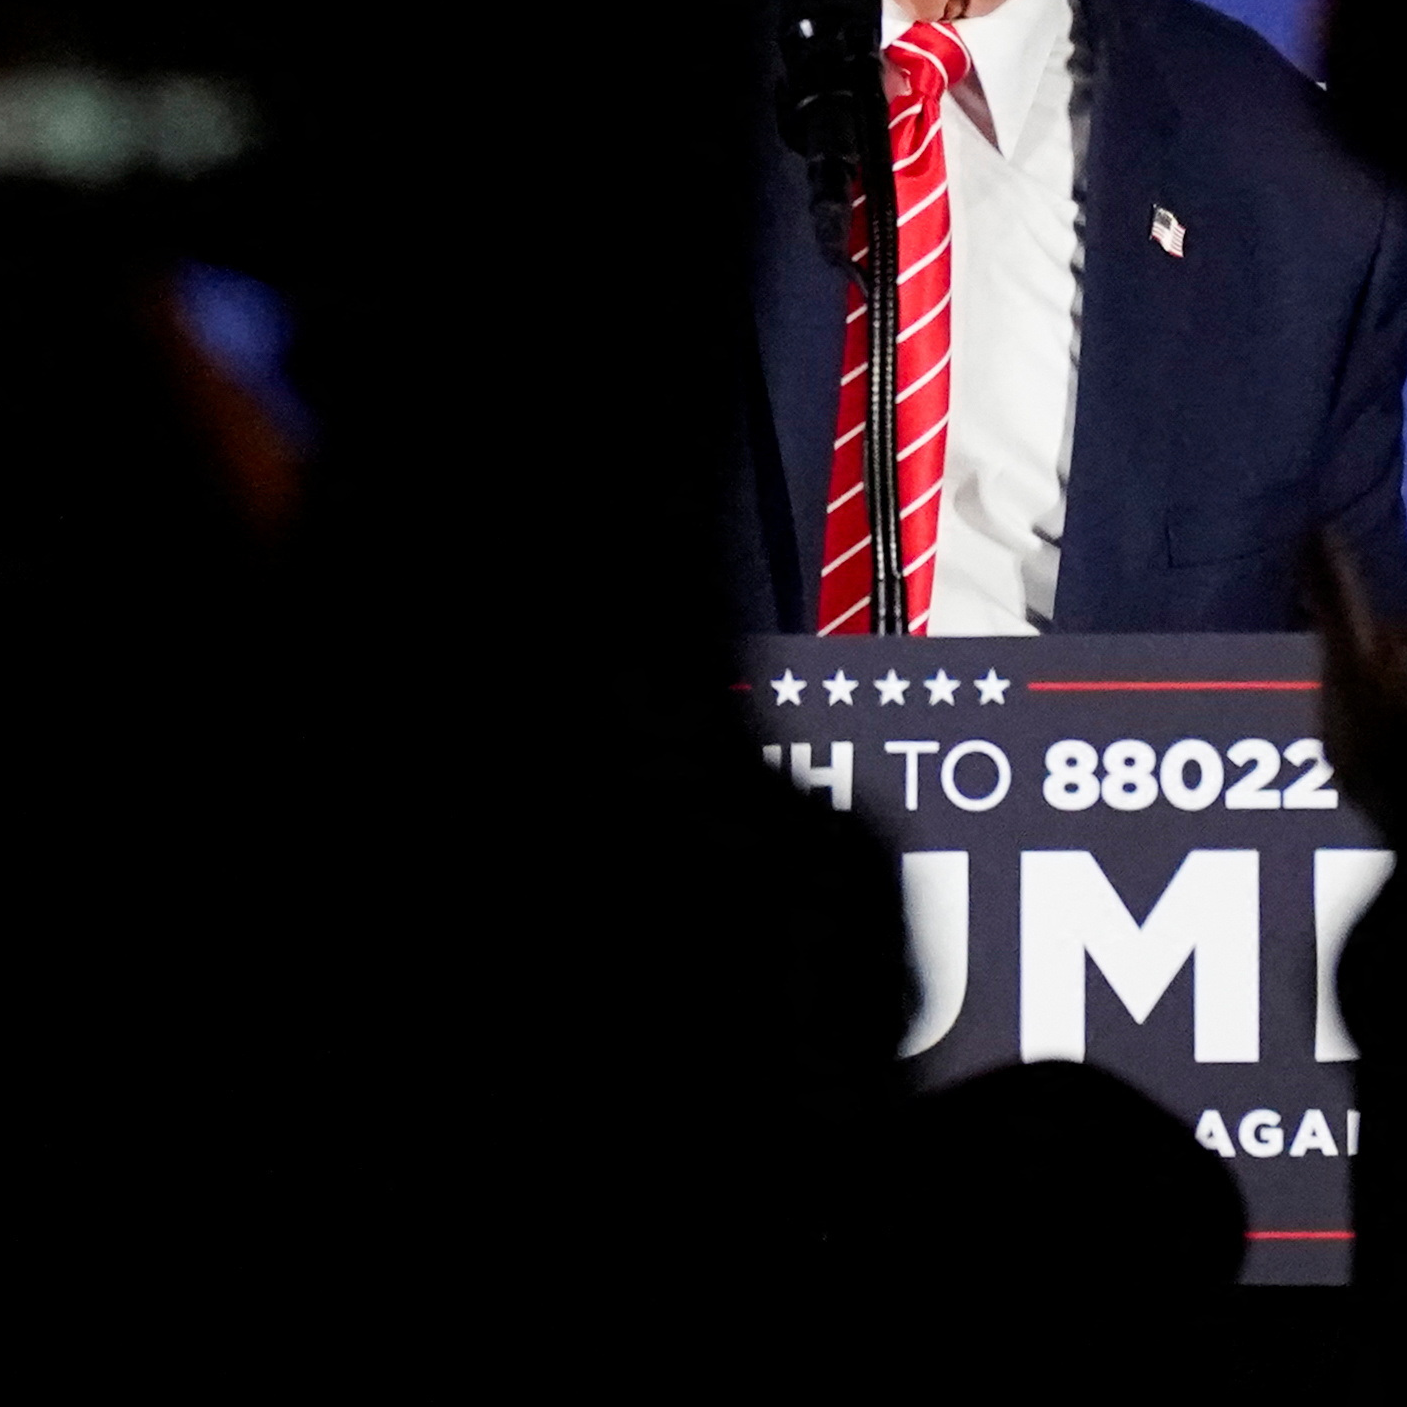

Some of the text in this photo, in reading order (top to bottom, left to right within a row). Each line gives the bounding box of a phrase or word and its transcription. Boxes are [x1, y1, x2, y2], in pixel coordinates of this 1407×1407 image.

[763, 739, 1339, 812] H TO 88022
